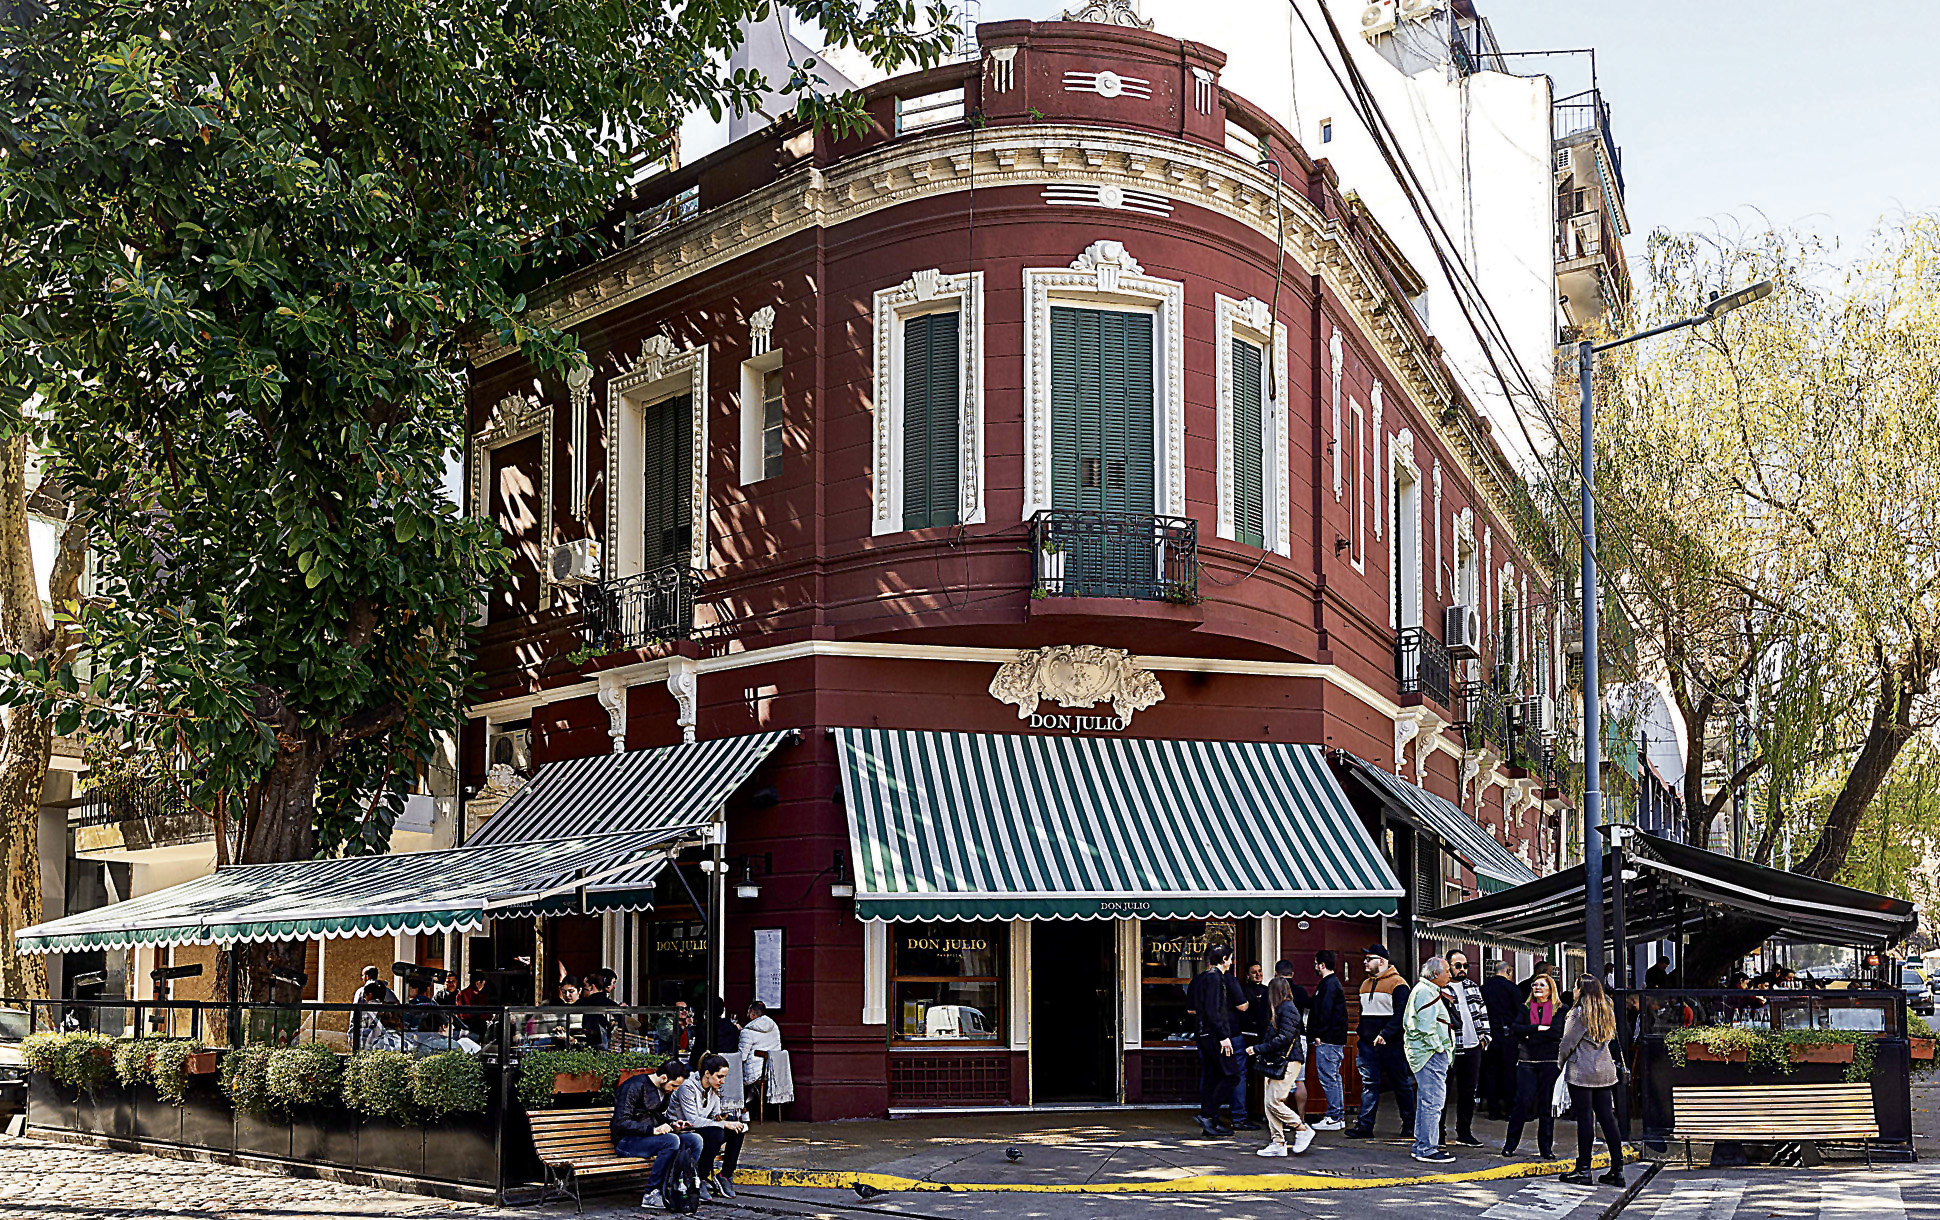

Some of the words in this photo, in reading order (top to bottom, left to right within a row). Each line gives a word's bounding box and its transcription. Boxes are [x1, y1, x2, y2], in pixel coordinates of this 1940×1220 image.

[1029, 713, 1071, 729] DON
[1071, 715, 1126, 734] JULIO
[1100, 902, 1122, 910] DON
[1122, 901, 1151, 912] JULIO
[656, 940, 679, 951] DON
[907, 938, 940, 950] DON
[942, 938, 987, 952] JULIO
[1151, 941, 1183, 953] DON
